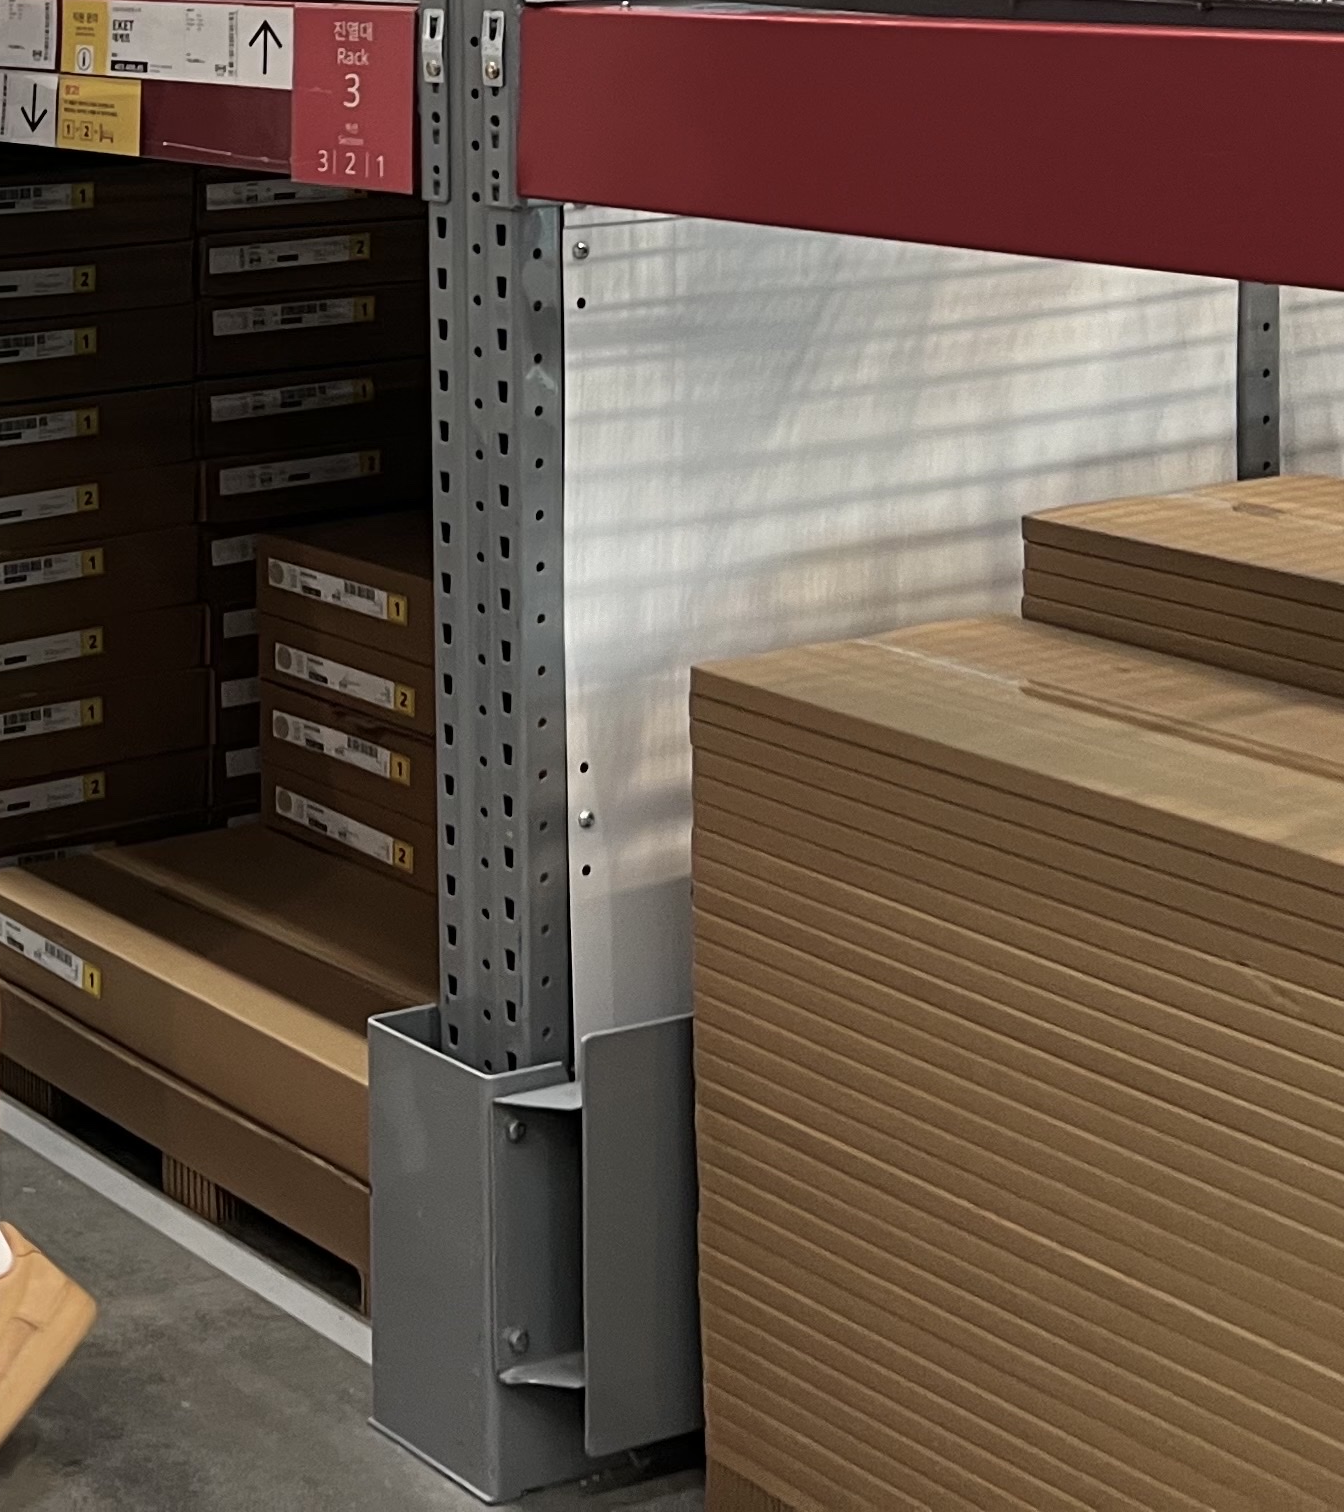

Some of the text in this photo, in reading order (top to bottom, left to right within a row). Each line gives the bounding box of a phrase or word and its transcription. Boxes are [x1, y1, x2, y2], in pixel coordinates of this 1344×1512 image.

[333, 21, 374, 42] 진열대
[336, 47, 370, 66] Rack
[343, 73, 360, 108] 3
[317, 149, 384, 178] 3 2 1
[79, 188, 86, 203] 1
[356, 240, 364, 255] 2
[80, 271, 89, 287] 2
[82, 334, 89, 348] 1
[84, 414, 91, 430] 1
[84, 491, 93, 506] 2
[88, 555, 96, 570] 1
[394, 600, 400, 617] 1
[89, 635, 97, 649] 2
[399, 691, 408, 709] 2
[88, 705, 95, 720] 1
[397, 761, 403, 777] 1
[91, 780, 100, 794] 2
[398, 848, 406, 864] 2
[88, 972, 96, 988] 1
